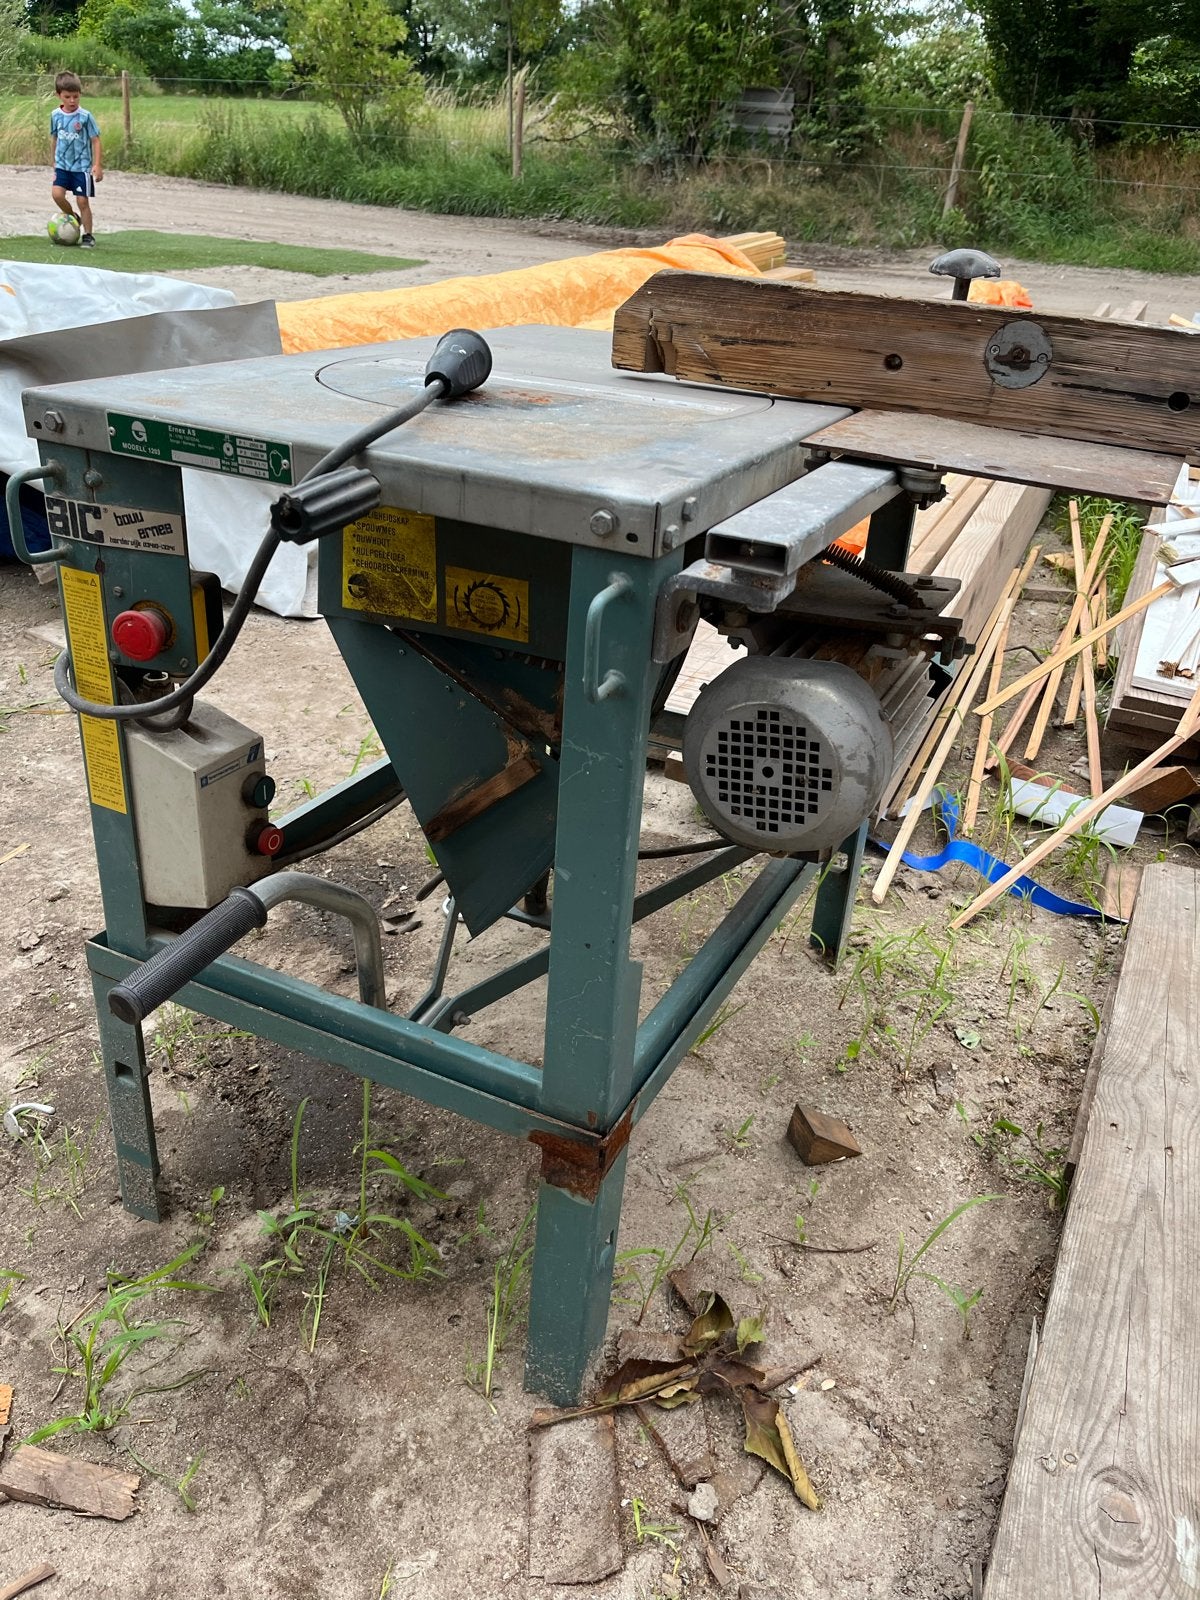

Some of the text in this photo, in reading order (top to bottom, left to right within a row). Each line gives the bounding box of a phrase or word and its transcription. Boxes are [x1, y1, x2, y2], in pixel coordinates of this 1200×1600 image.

[168, 425, 186, 434] Ernex
[187, 428, 196, 437] AS
[122, 442, 147, 453] MODELL
